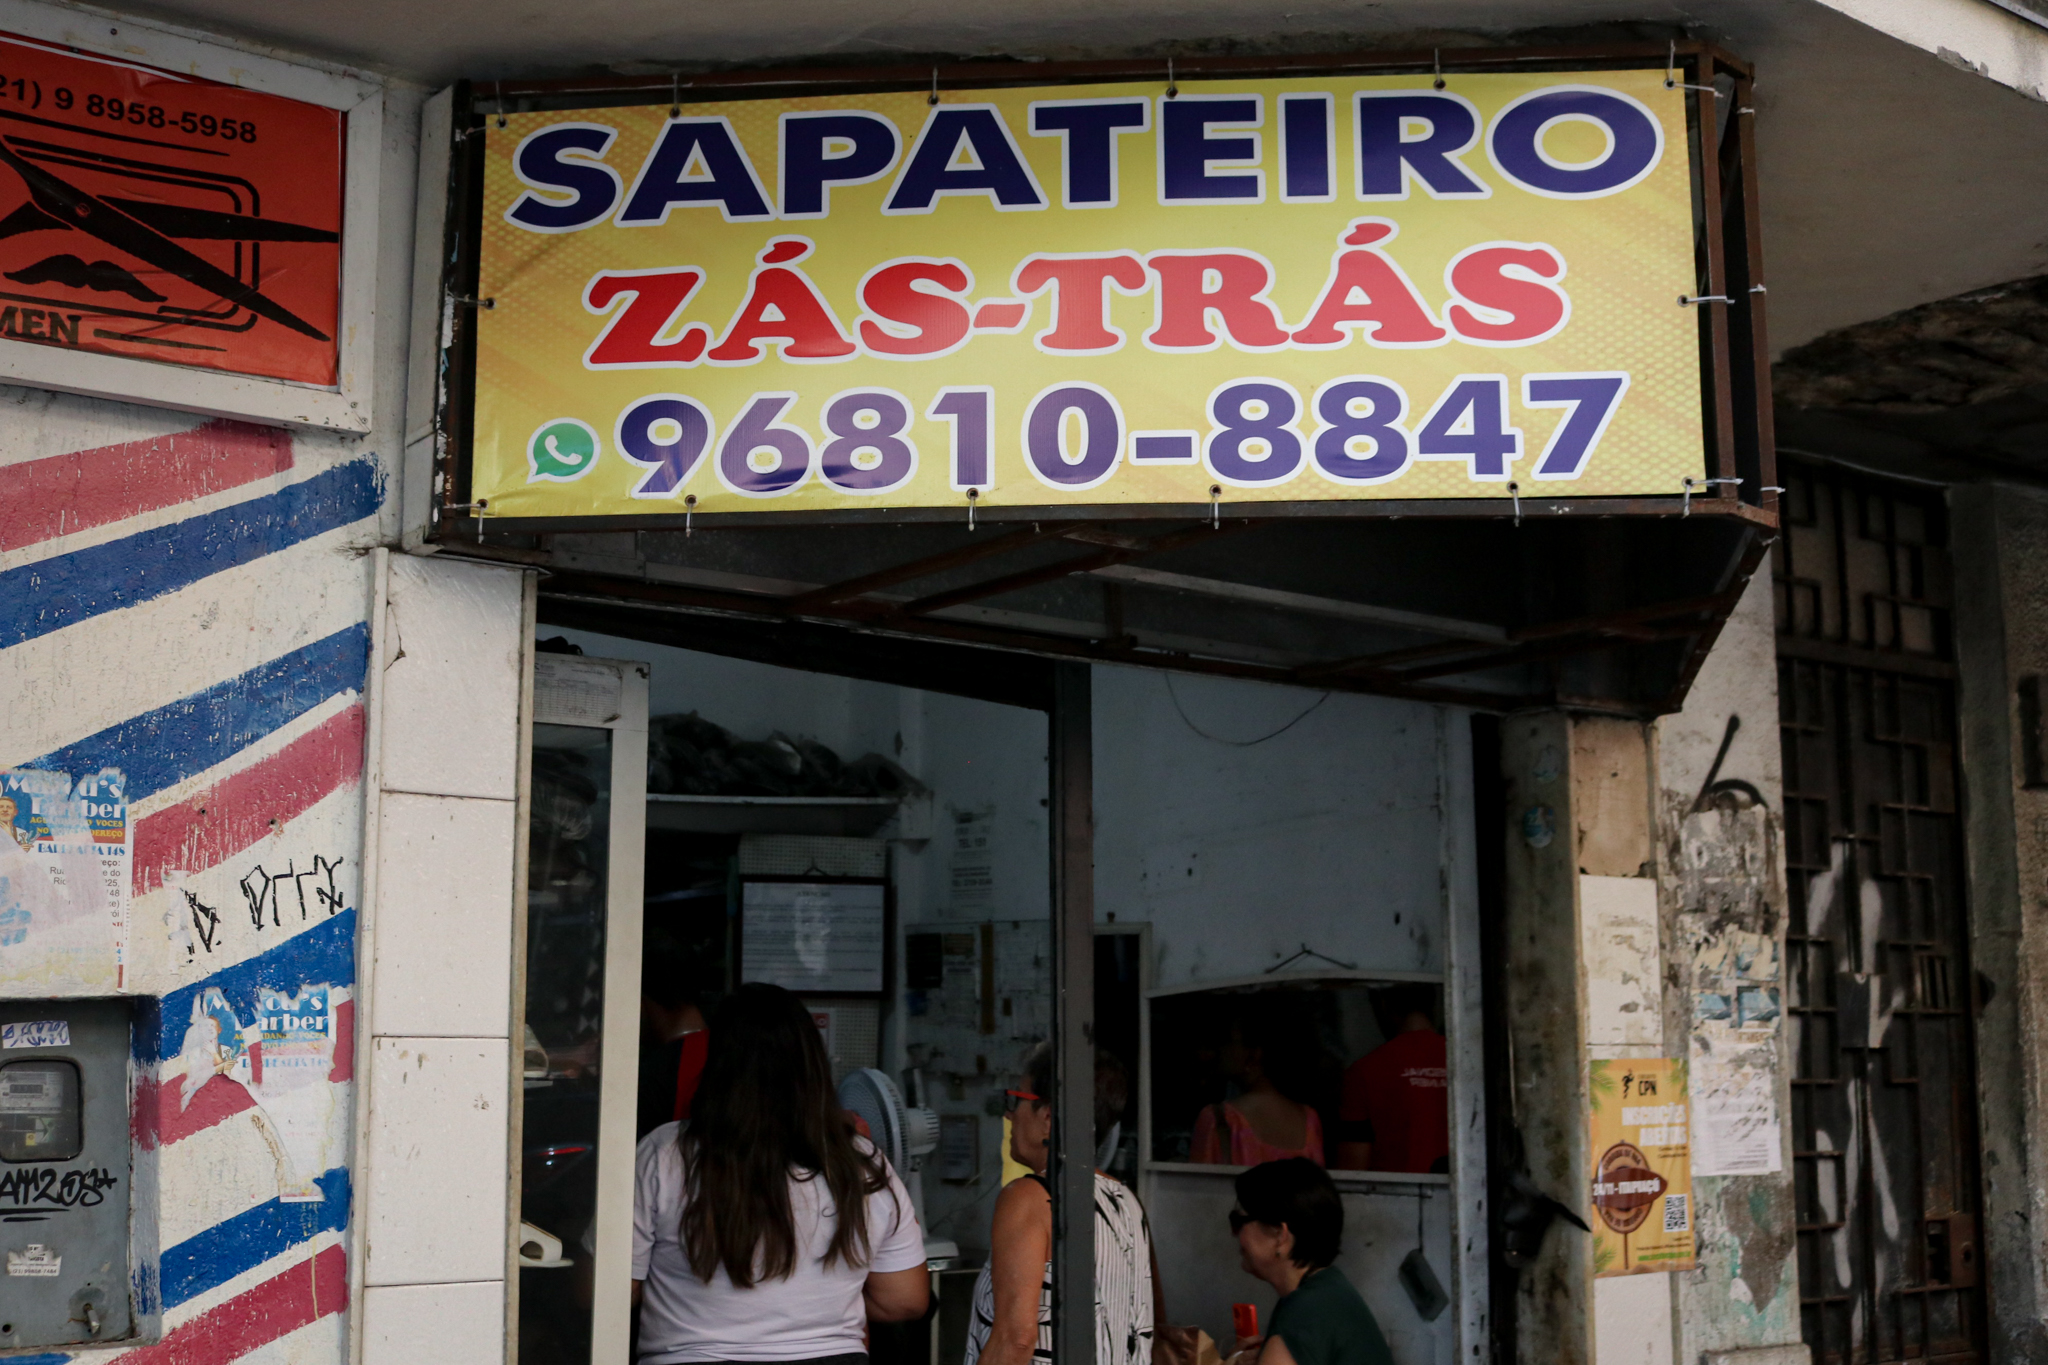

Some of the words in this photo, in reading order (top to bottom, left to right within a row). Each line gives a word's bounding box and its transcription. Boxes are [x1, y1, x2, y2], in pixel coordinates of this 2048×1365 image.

[54, 87, 74, 110] 9
[86, 94, 257, 143] 8958-5958
[507, 85, 1663, 231] SAPATEIRO
[584, 217, 1569, 370] ZÁS-TRÁS
[616, 372, 1629, 497] 96810-8847
[96, 820, 124, 828] VOCES
[107, 846, 125, 857] 148
[110, 868, 121, 877] do
[106, 889, 120, 897] 48
[1638, 1080, 1657, 1096] CPN
